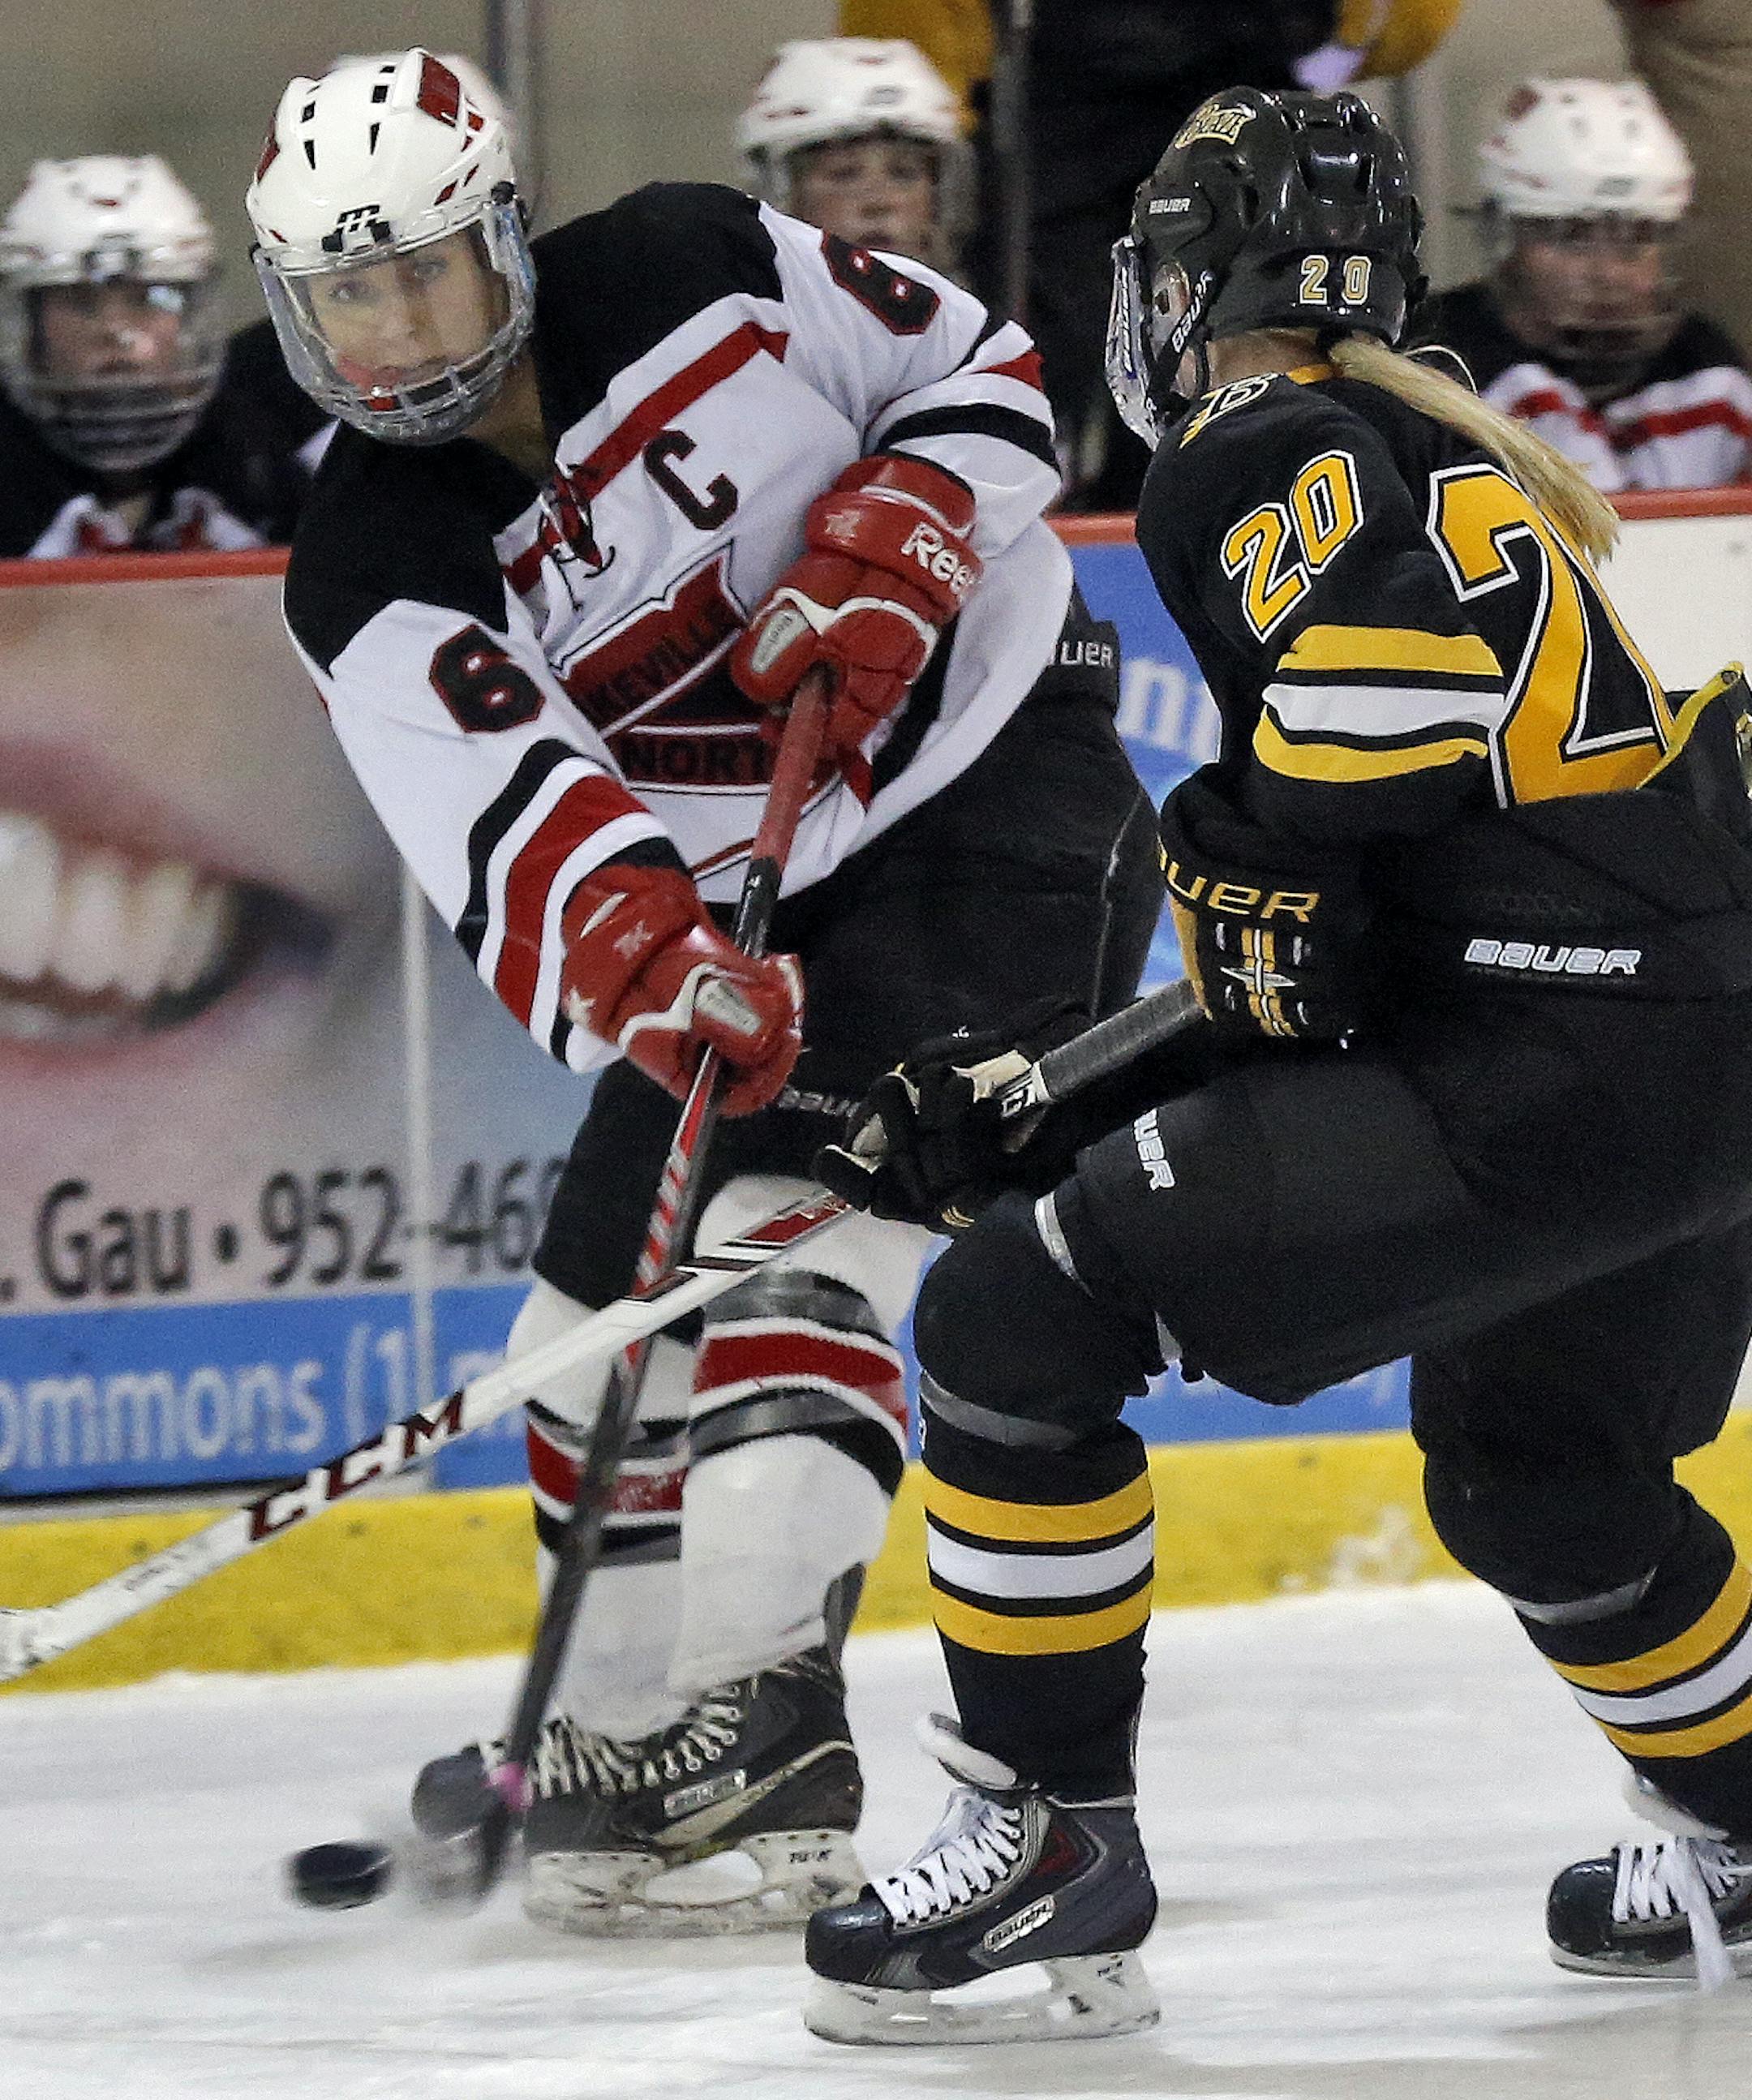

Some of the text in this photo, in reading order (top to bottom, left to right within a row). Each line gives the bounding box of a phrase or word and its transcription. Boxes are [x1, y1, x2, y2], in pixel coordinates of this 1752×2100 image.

[821, 230, 940, 335] 6
[1299, 255, 1372, 306] 20
[643, 430, 738, 530] C
[900, 522, 983, 596] Ree
[1220, 449, 1364, 643] 20
[429, 622, 547, 733] 6
[579, 596, 740, 724] KEVILLE
[1059, 639, 1114, 668] UER
[1425, 462, 1674, 810] 2
[620, 737, 771, 779] NORT
[1157, 835, 1321, 923] UER
[1464, 938, 1642, 975] BAUER
[1133, 1107, 1176, 1192] UER
[37, 1178, 191, 1299] Gau
[250, 1389, 464, 1541] CCM
